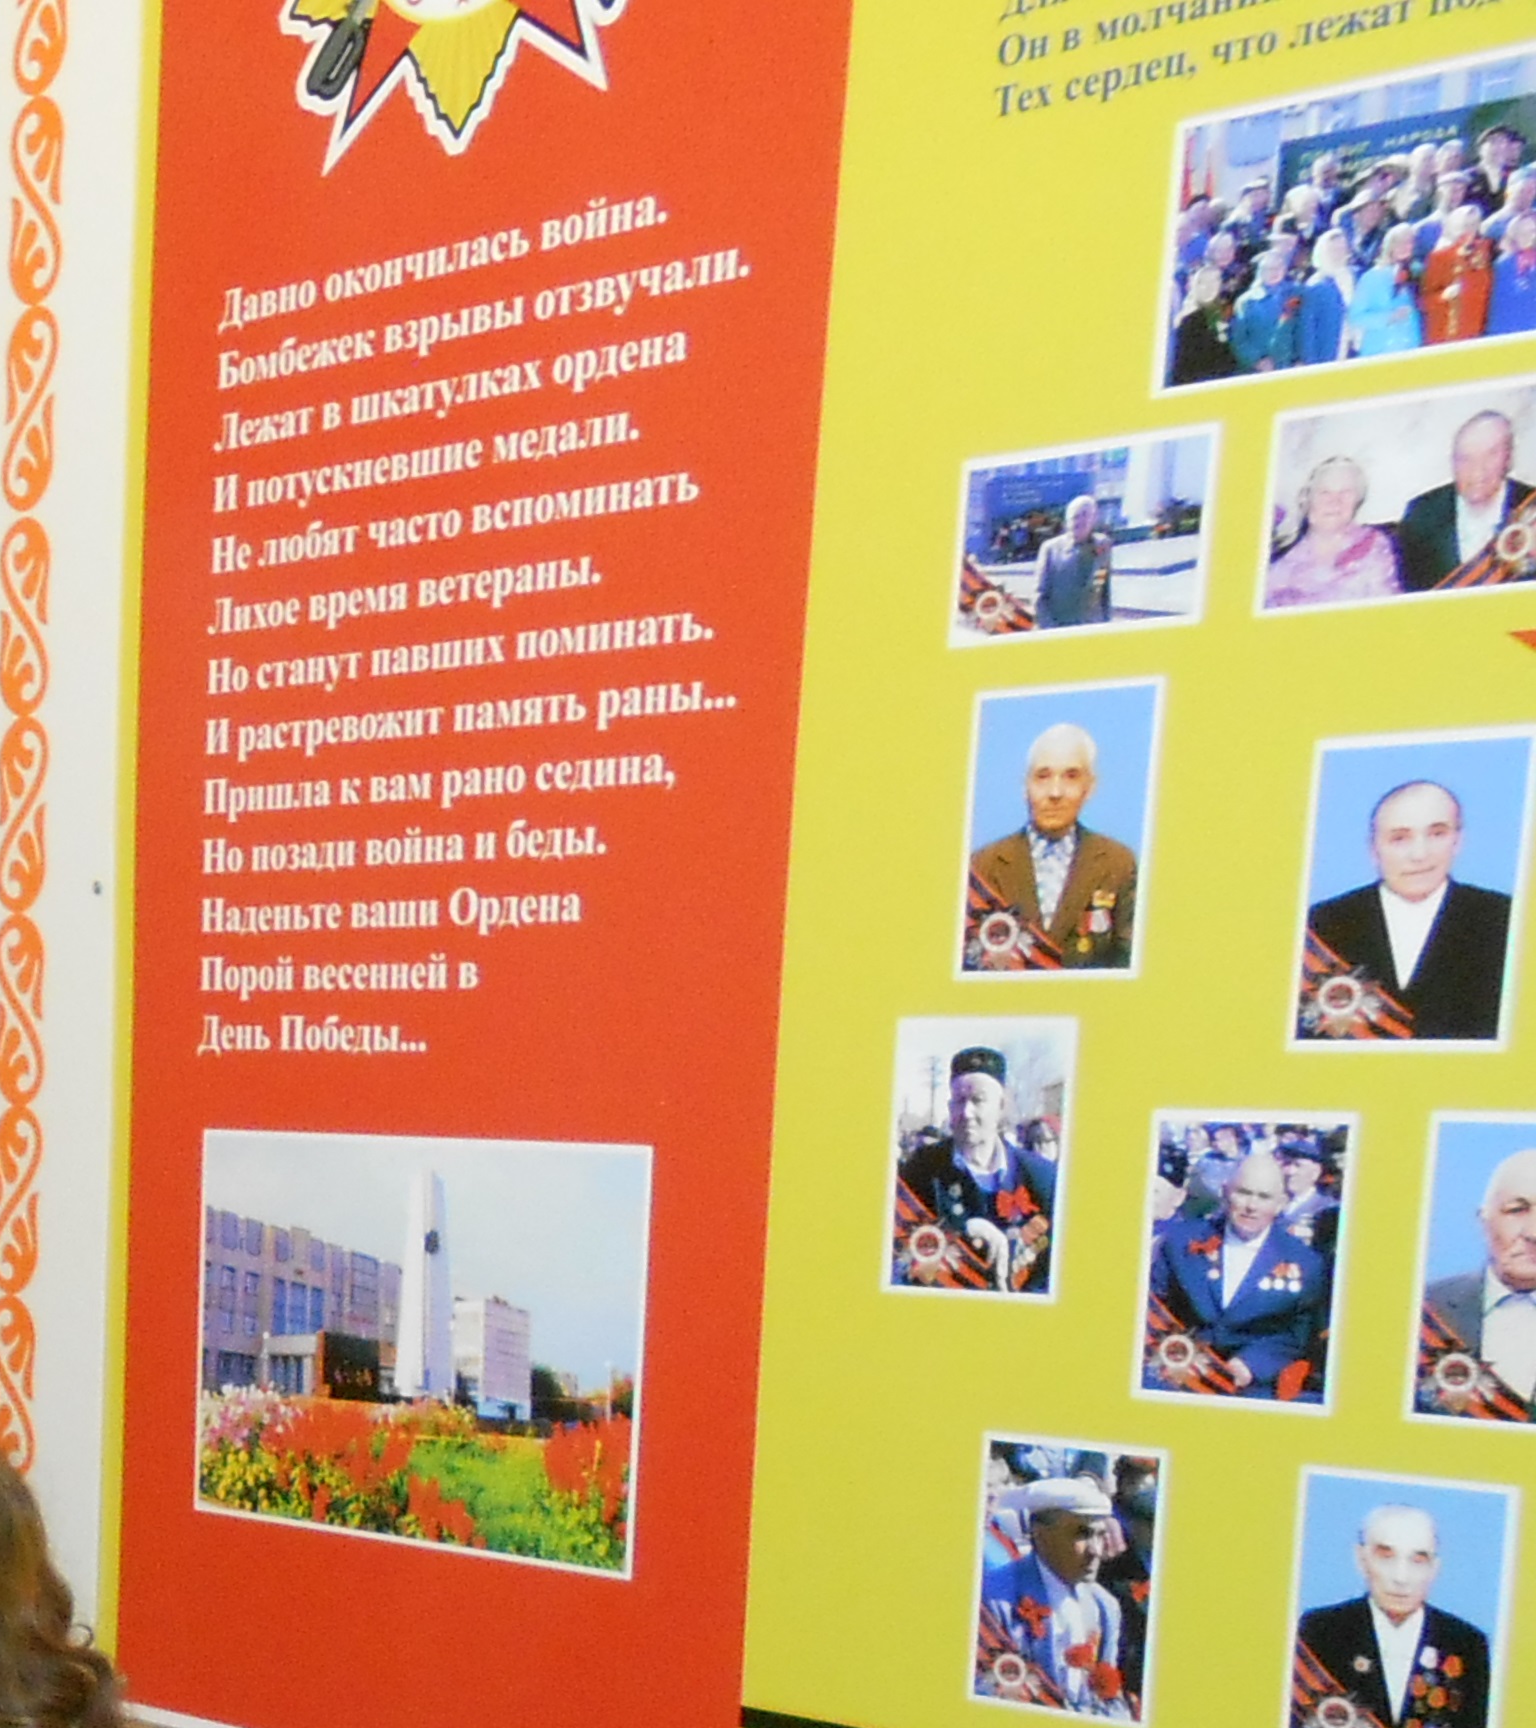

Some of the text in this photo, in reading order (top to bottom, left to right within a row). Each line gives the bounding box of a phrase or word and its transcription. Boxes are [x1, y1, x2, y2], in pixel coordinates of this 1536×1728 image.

[995, 83, 1051, 117] Тех
[1065, 52, 1197, 103] сердец,
[1213, 31, 1277, 65] что
[1289, 0, 1411, 49] лежат
[998, 33, 1048, 66] Он
[1062, 28, 1081, 51] в
[1096, 0, 1271, 43] молчан
[218, 195, 668, 333] Давно окончилась война.
[218, 248, 751, 389] Бомбежек взрывы отзвучали.
[213, 331, 688, 452] Лежат в шкатулках ордена
[214, 412, 640, 513] И потускневшие медали.
[212, 472, 700, 574] Не любят часто вспоминать
[207, 556, 602, 635] Лихое время ветераны.
[208, 612, 714, 695] Но станут павших поминать.
[206, 681, 737, 762] И растревожит память раны...
[204, 754, 676, 823] Пришла к вам рано седина,
[203, 819, 606, 874] Но позади война и беды.
[202, 887, 581, 936] Наденьте ваши Ордена
[201, 953, 480, 1001] Порой весенней в
[197, 1015, 426, 1054] День Победы...
